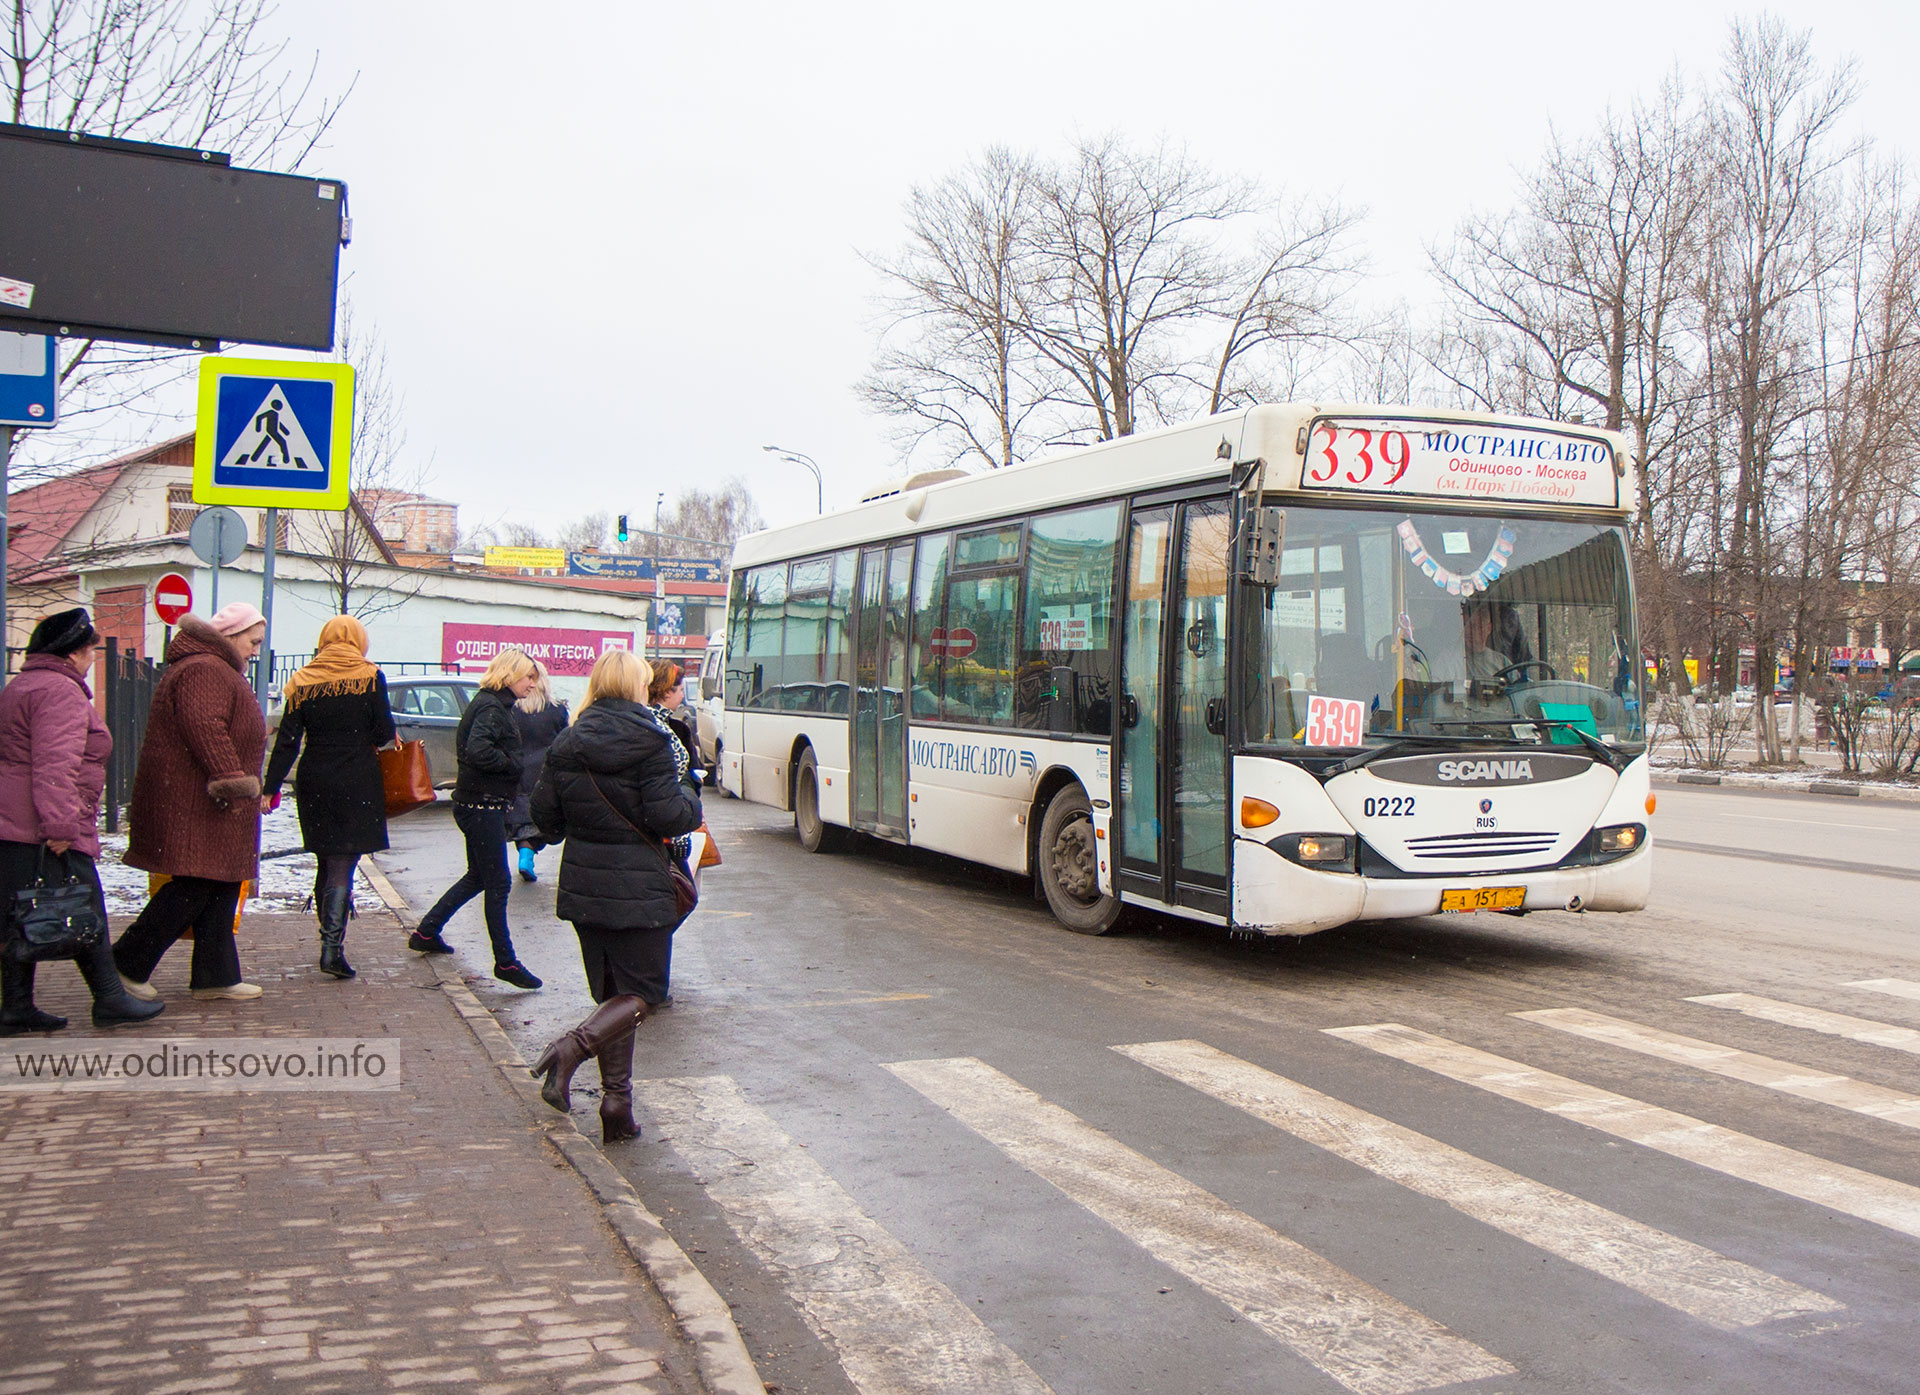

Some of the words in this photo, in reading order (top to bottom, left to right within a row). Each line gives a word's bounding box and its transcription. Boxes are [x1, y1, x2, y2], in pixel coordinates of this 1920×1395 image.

[1311, 427, 1411, 486] 339
[1421, 431, 1607, 465] МОСТРАНСАВТО
[1449, 457, 1523, 479] Одинцово
[1535, 464, 1587, 482] Москва
[1436, 474, 1460, 491] (м.
[1464, 476, 1506, 495] Парк
[1508, 480, 1576, 500] Победы)
[1040, 621, 1062, 650] 339
[456, 640, 496, 657] ОТДЕЛ
[552, 644, 596, 660] ТРЕСТА
[1308, 698, 1361, 746] 339
[910, 739, 1017, 778] МОСТРАНСАВТО
[1437, 760, 1534, 781] SCANIA
[1364, 796, 1416, 817] 0222
[1476, 817, 1495, 828] RUS
[1474, 890, 1499, 906] 151
